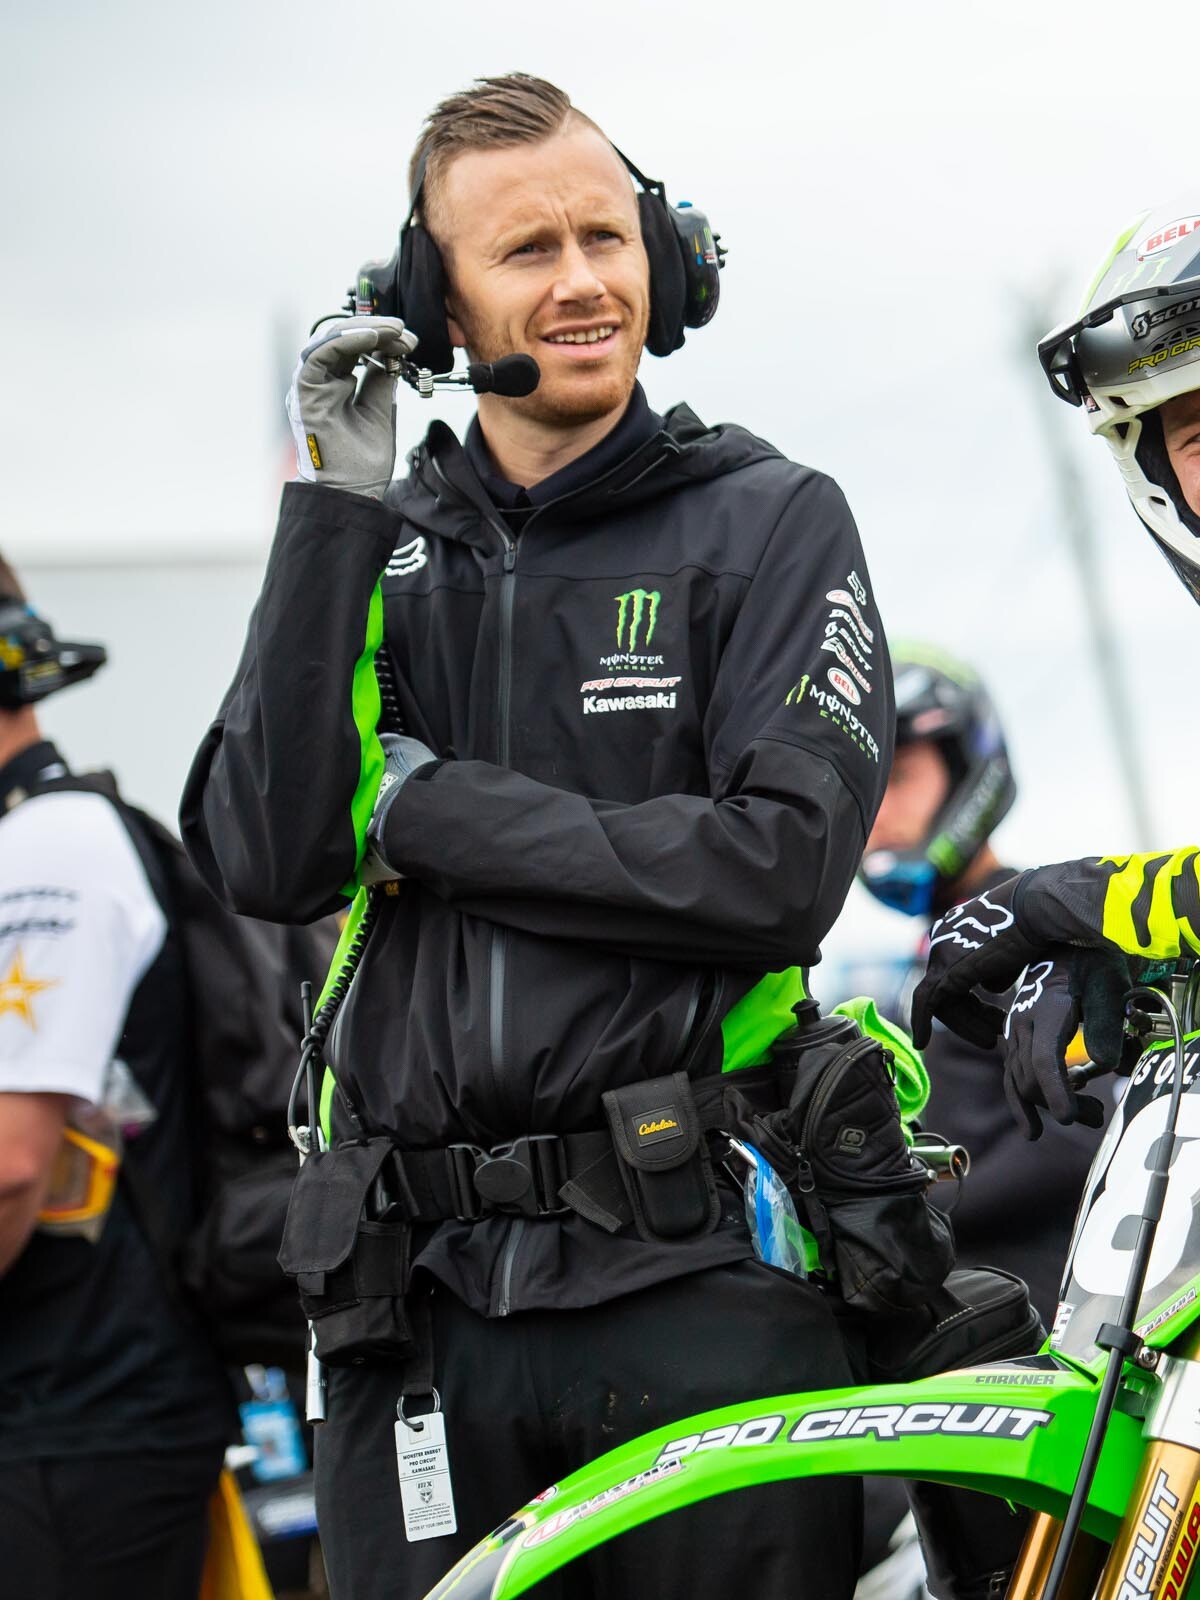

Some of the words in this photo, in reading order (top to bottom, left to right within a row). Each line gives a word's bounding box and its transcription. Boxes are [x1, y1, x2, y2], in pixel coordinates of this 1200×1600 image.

[1128, 349, 1167, 375] PRO
[600, 652, 664, 666] MONSTER
[832, 672, 858, 700] BELL
[583, 692, 677, 714] Kawasaki
[809, 684, 880, 763] MONSTER
[975, 1374, 1056, 1386] FORKNER
[789, 1403, 1055, 1441] CIRCUIT
[403, 1450, 424, 1460] MONSTER
